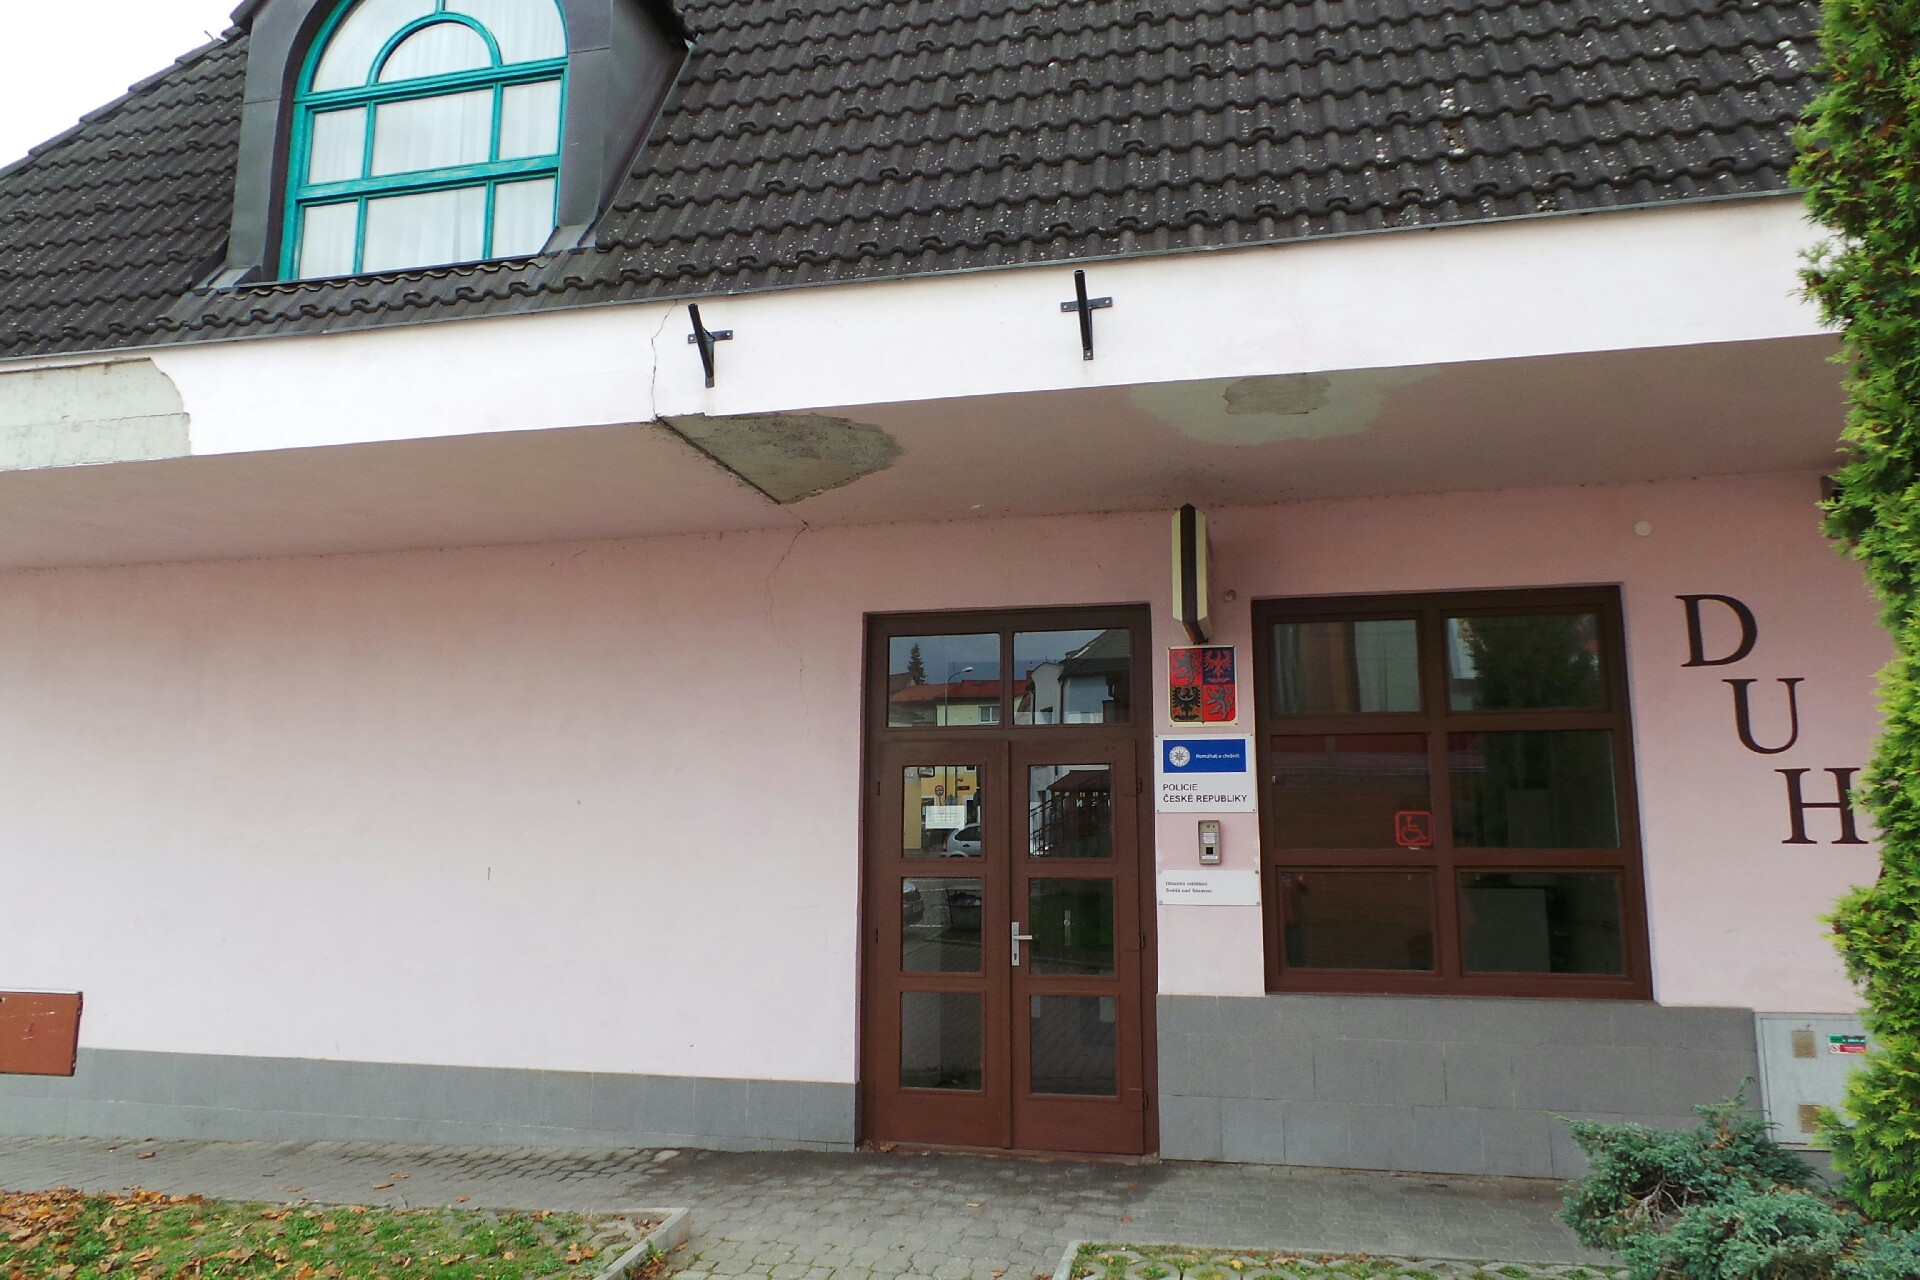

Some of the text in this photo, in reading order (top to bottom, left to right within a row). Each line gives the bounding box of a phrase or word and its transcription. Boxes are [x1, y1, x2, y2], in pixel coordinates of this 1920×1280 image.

[1163, 783, 1198, 791] POLICIE
[1163, 793, 1248, 803] ČESKÉ REPUBLIKY
